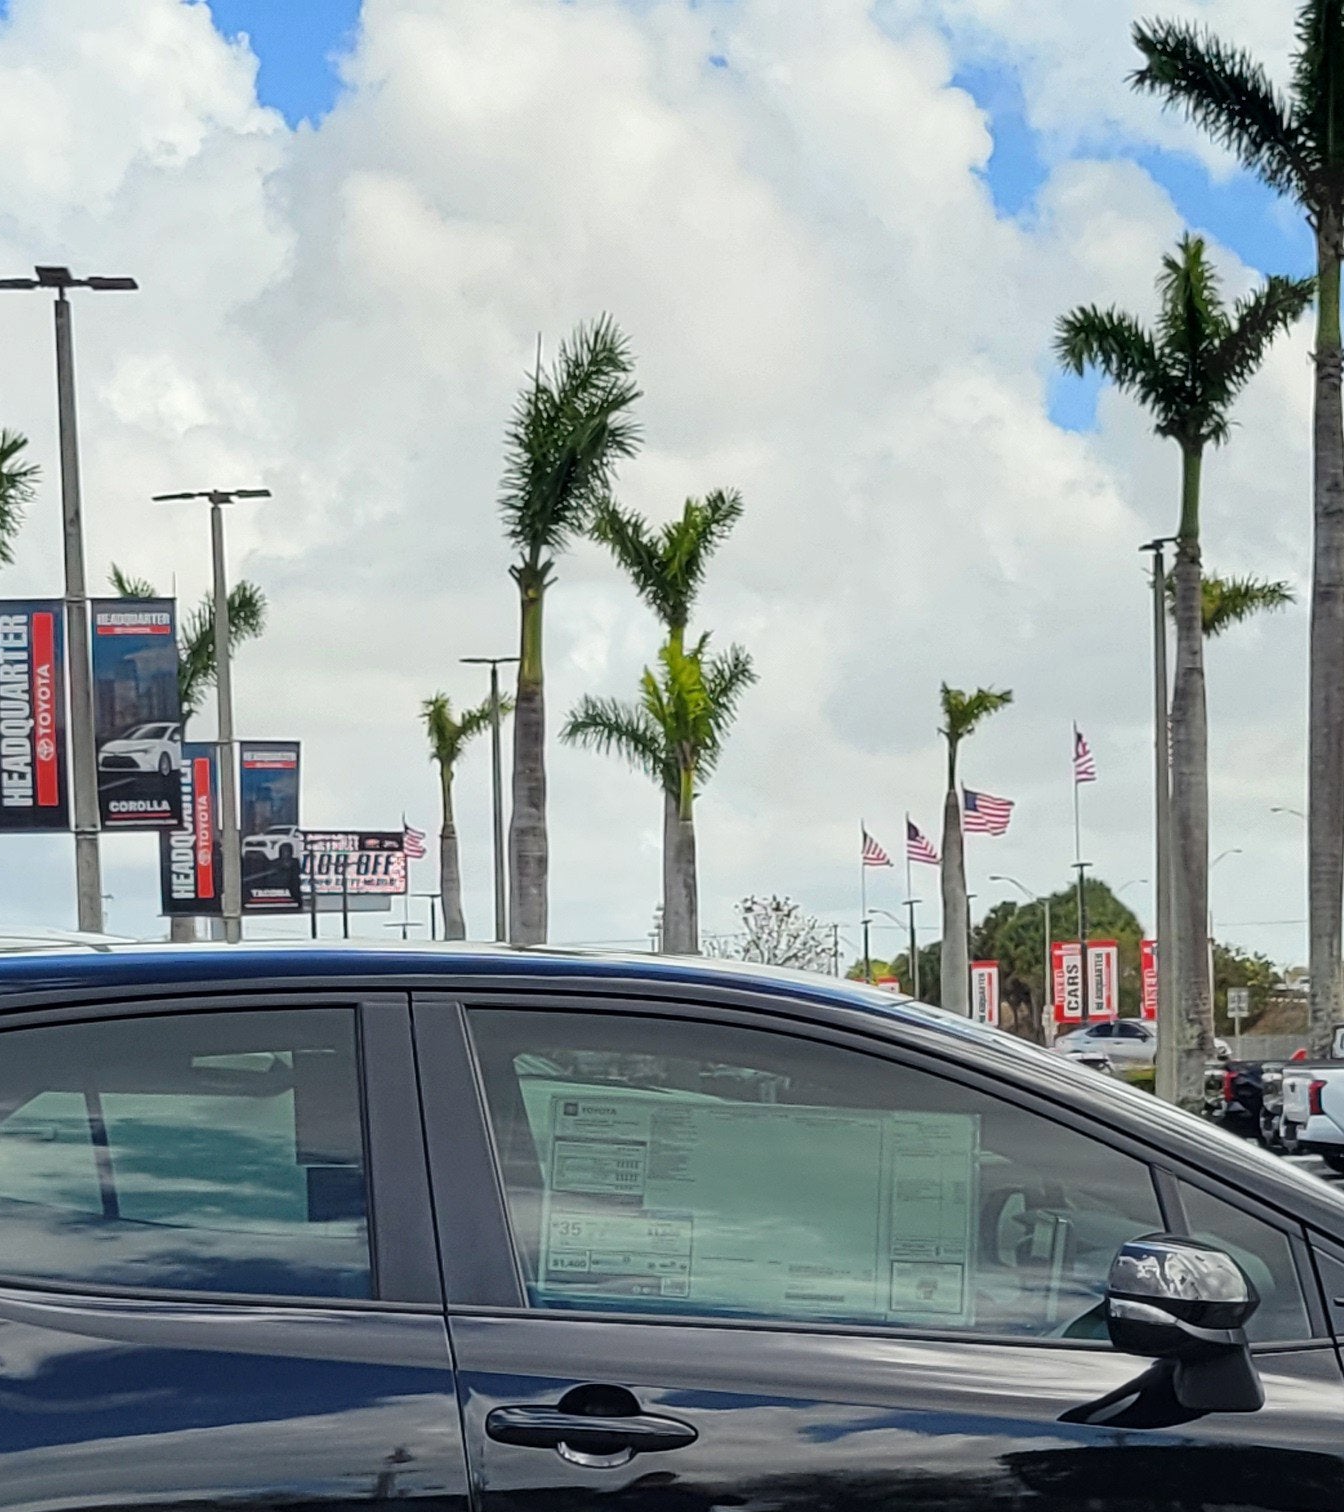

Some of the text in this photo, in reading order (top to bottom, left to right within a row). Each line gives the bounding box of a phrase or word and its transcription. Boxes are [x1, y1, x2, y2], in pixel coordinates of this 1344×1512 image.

[37, 663, 52, 736] TOYOTA
[109, 799, 171, 812] COROLLA
[197, 796, 209, 847] TOYOTA
[1055, 970, 1065, 1004] USED
[1067, 963, 1080, 1011] CARS
[559, 1221, 582, 1237] 35
